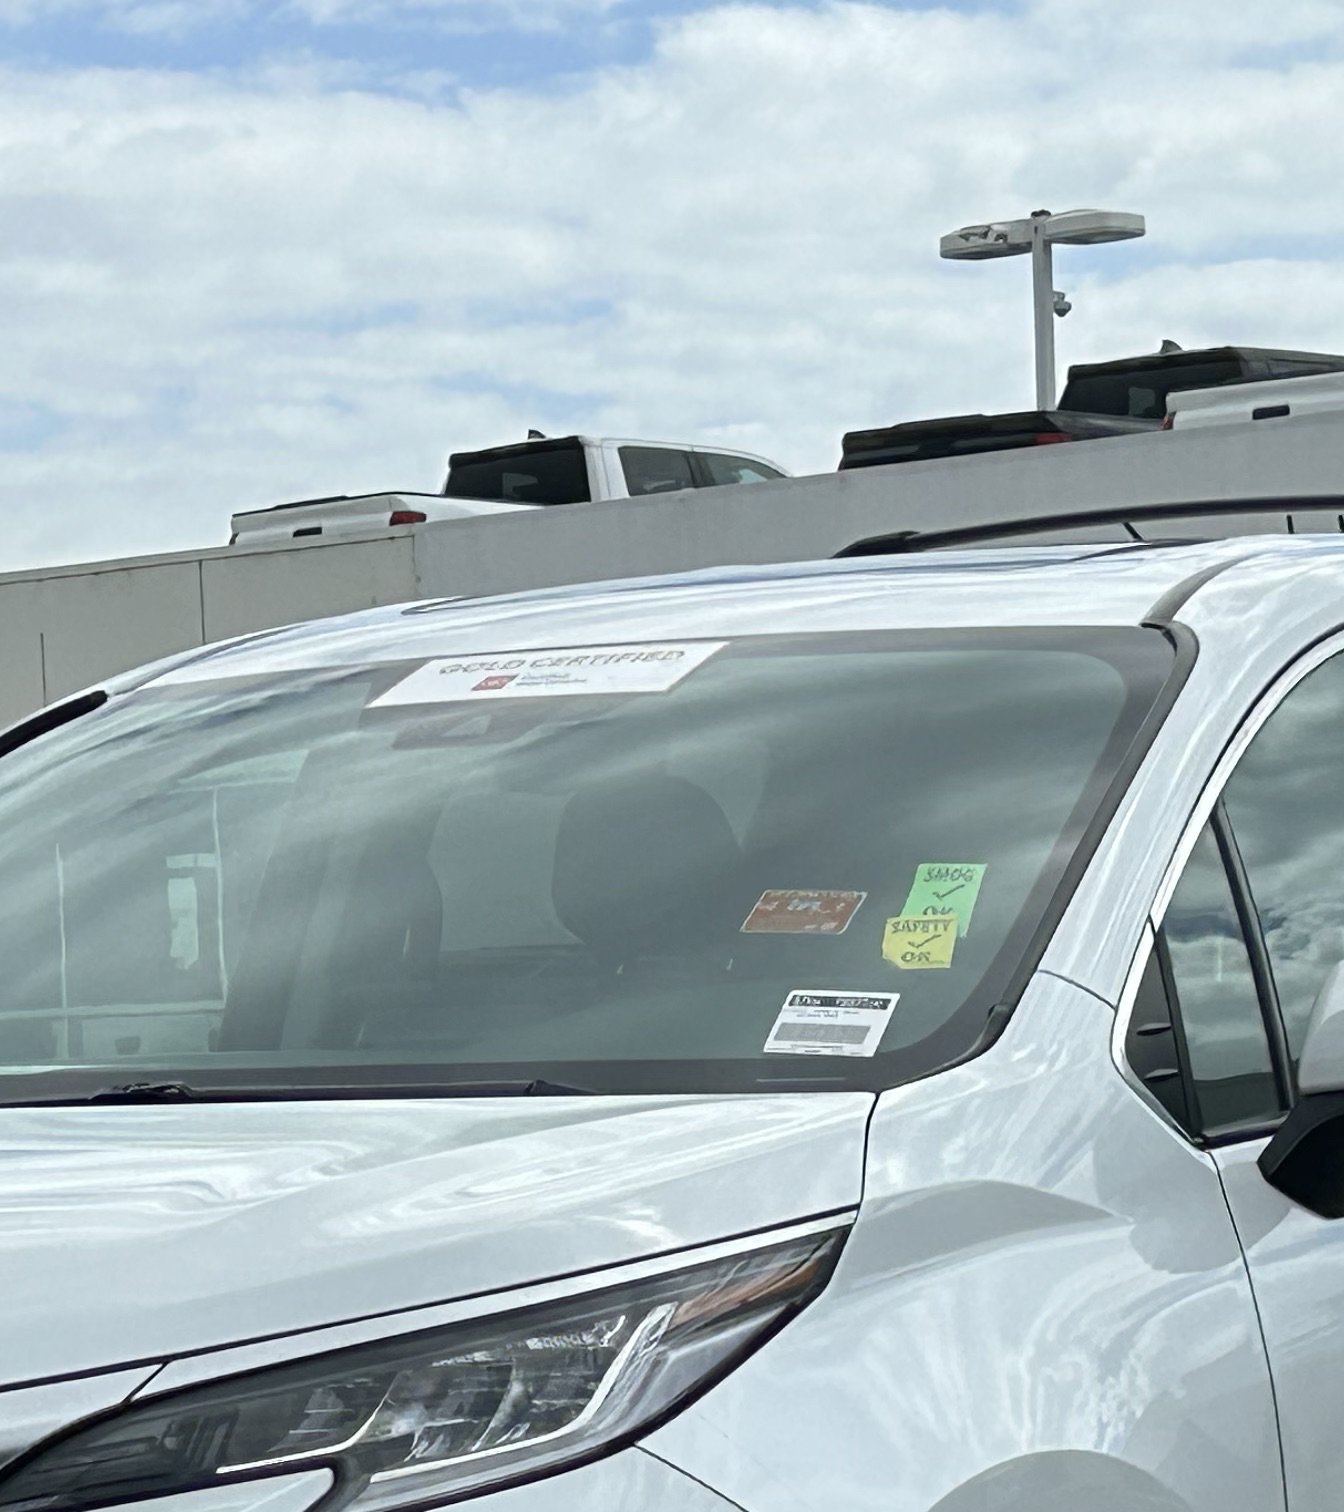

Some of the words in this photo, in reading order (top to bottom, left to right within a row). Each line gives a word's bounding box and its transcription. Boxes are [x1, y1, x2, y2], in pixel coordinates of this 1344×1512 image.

[440, 659, 525, 675] GOLD
[530, 650, 685, 669] CERTIFIED
[923, 867, 975, 883] SMOG
[900, 950, 932, 963] OK
